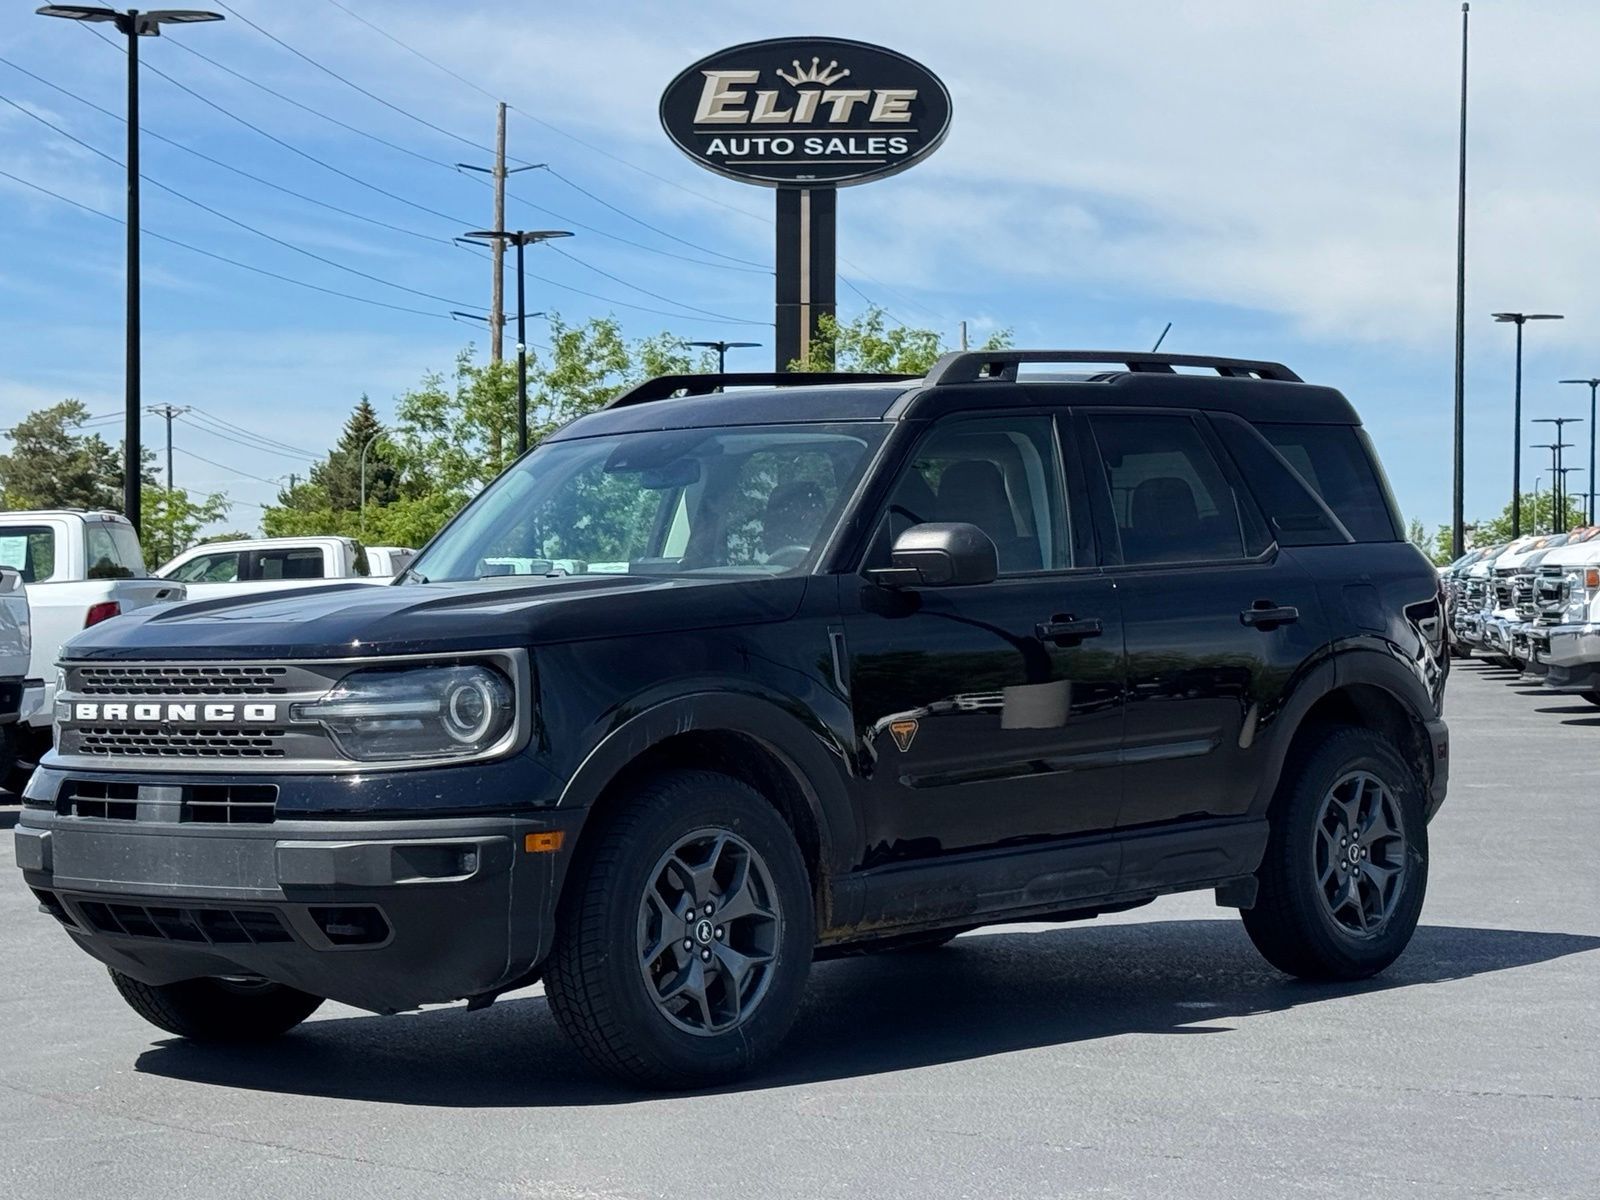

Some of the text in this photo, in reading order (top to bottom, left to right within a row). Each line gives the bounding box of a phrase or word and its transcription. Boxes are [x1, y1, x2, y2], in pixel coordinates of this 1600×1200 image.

[693, 70, 918, 124] ELITE
[706, 137, 909, 156] AUTO SALES
[75, 703, 277, 722] BRONCO
